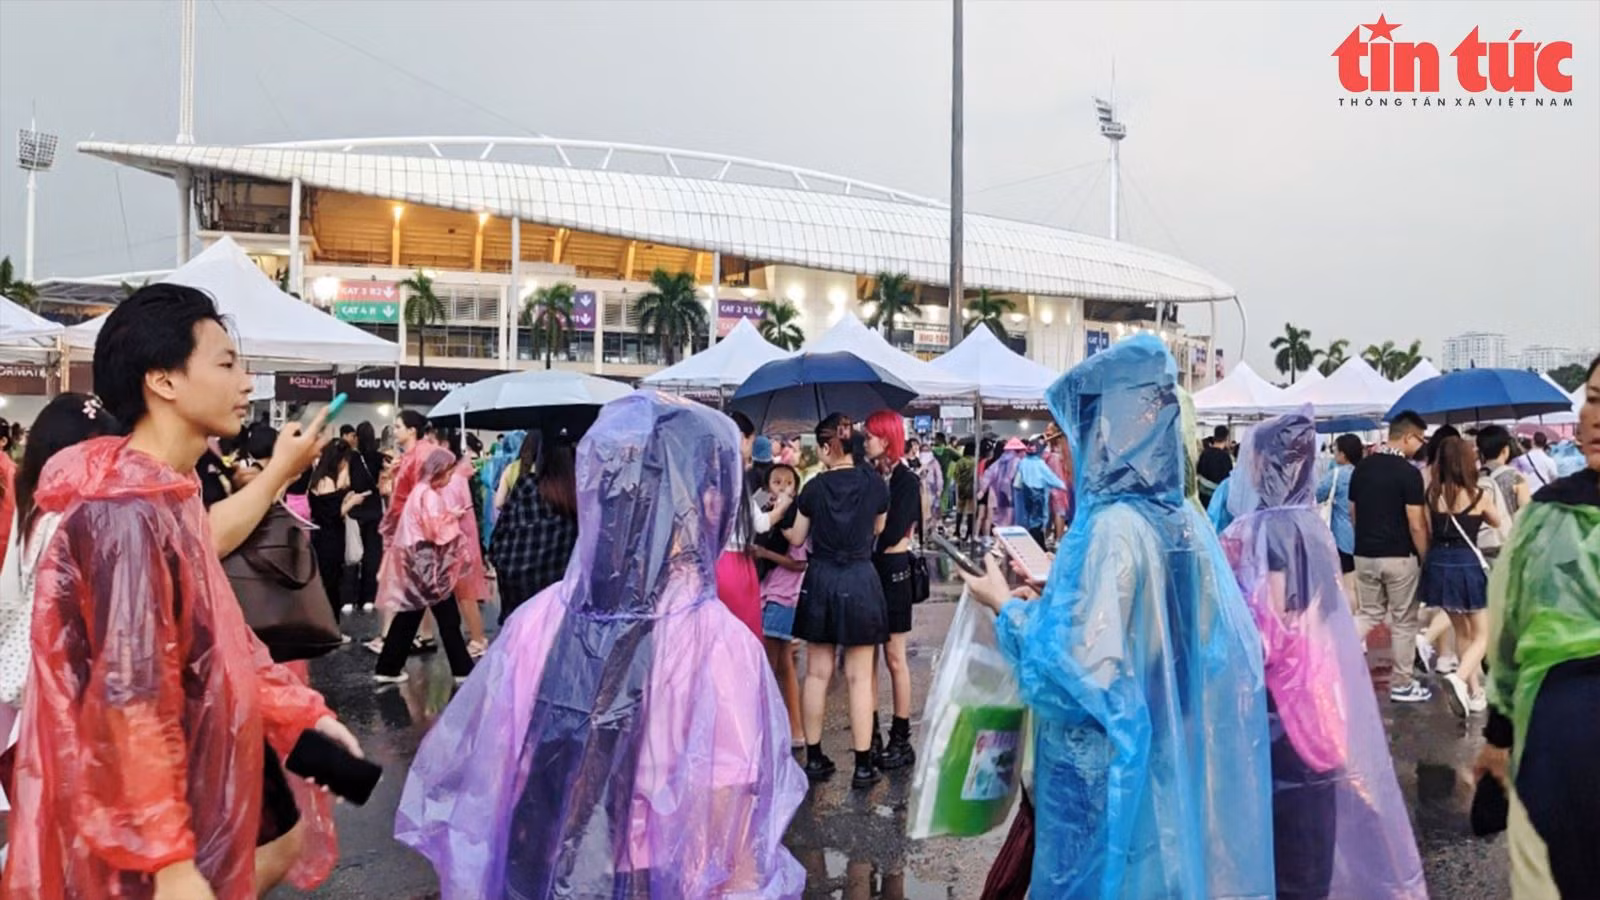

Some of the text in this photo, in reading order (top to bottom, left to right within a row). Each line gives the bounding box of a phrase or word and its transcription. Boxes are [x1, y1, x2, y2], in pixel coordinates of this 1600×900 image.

[341, 305, 359, 315] CAT
[720, 304, 735, 313] CAT
[736, 305, 742, 313] 2
[289, 376, 314, 385] BORN
[356, 378, 380, 389] KHU
